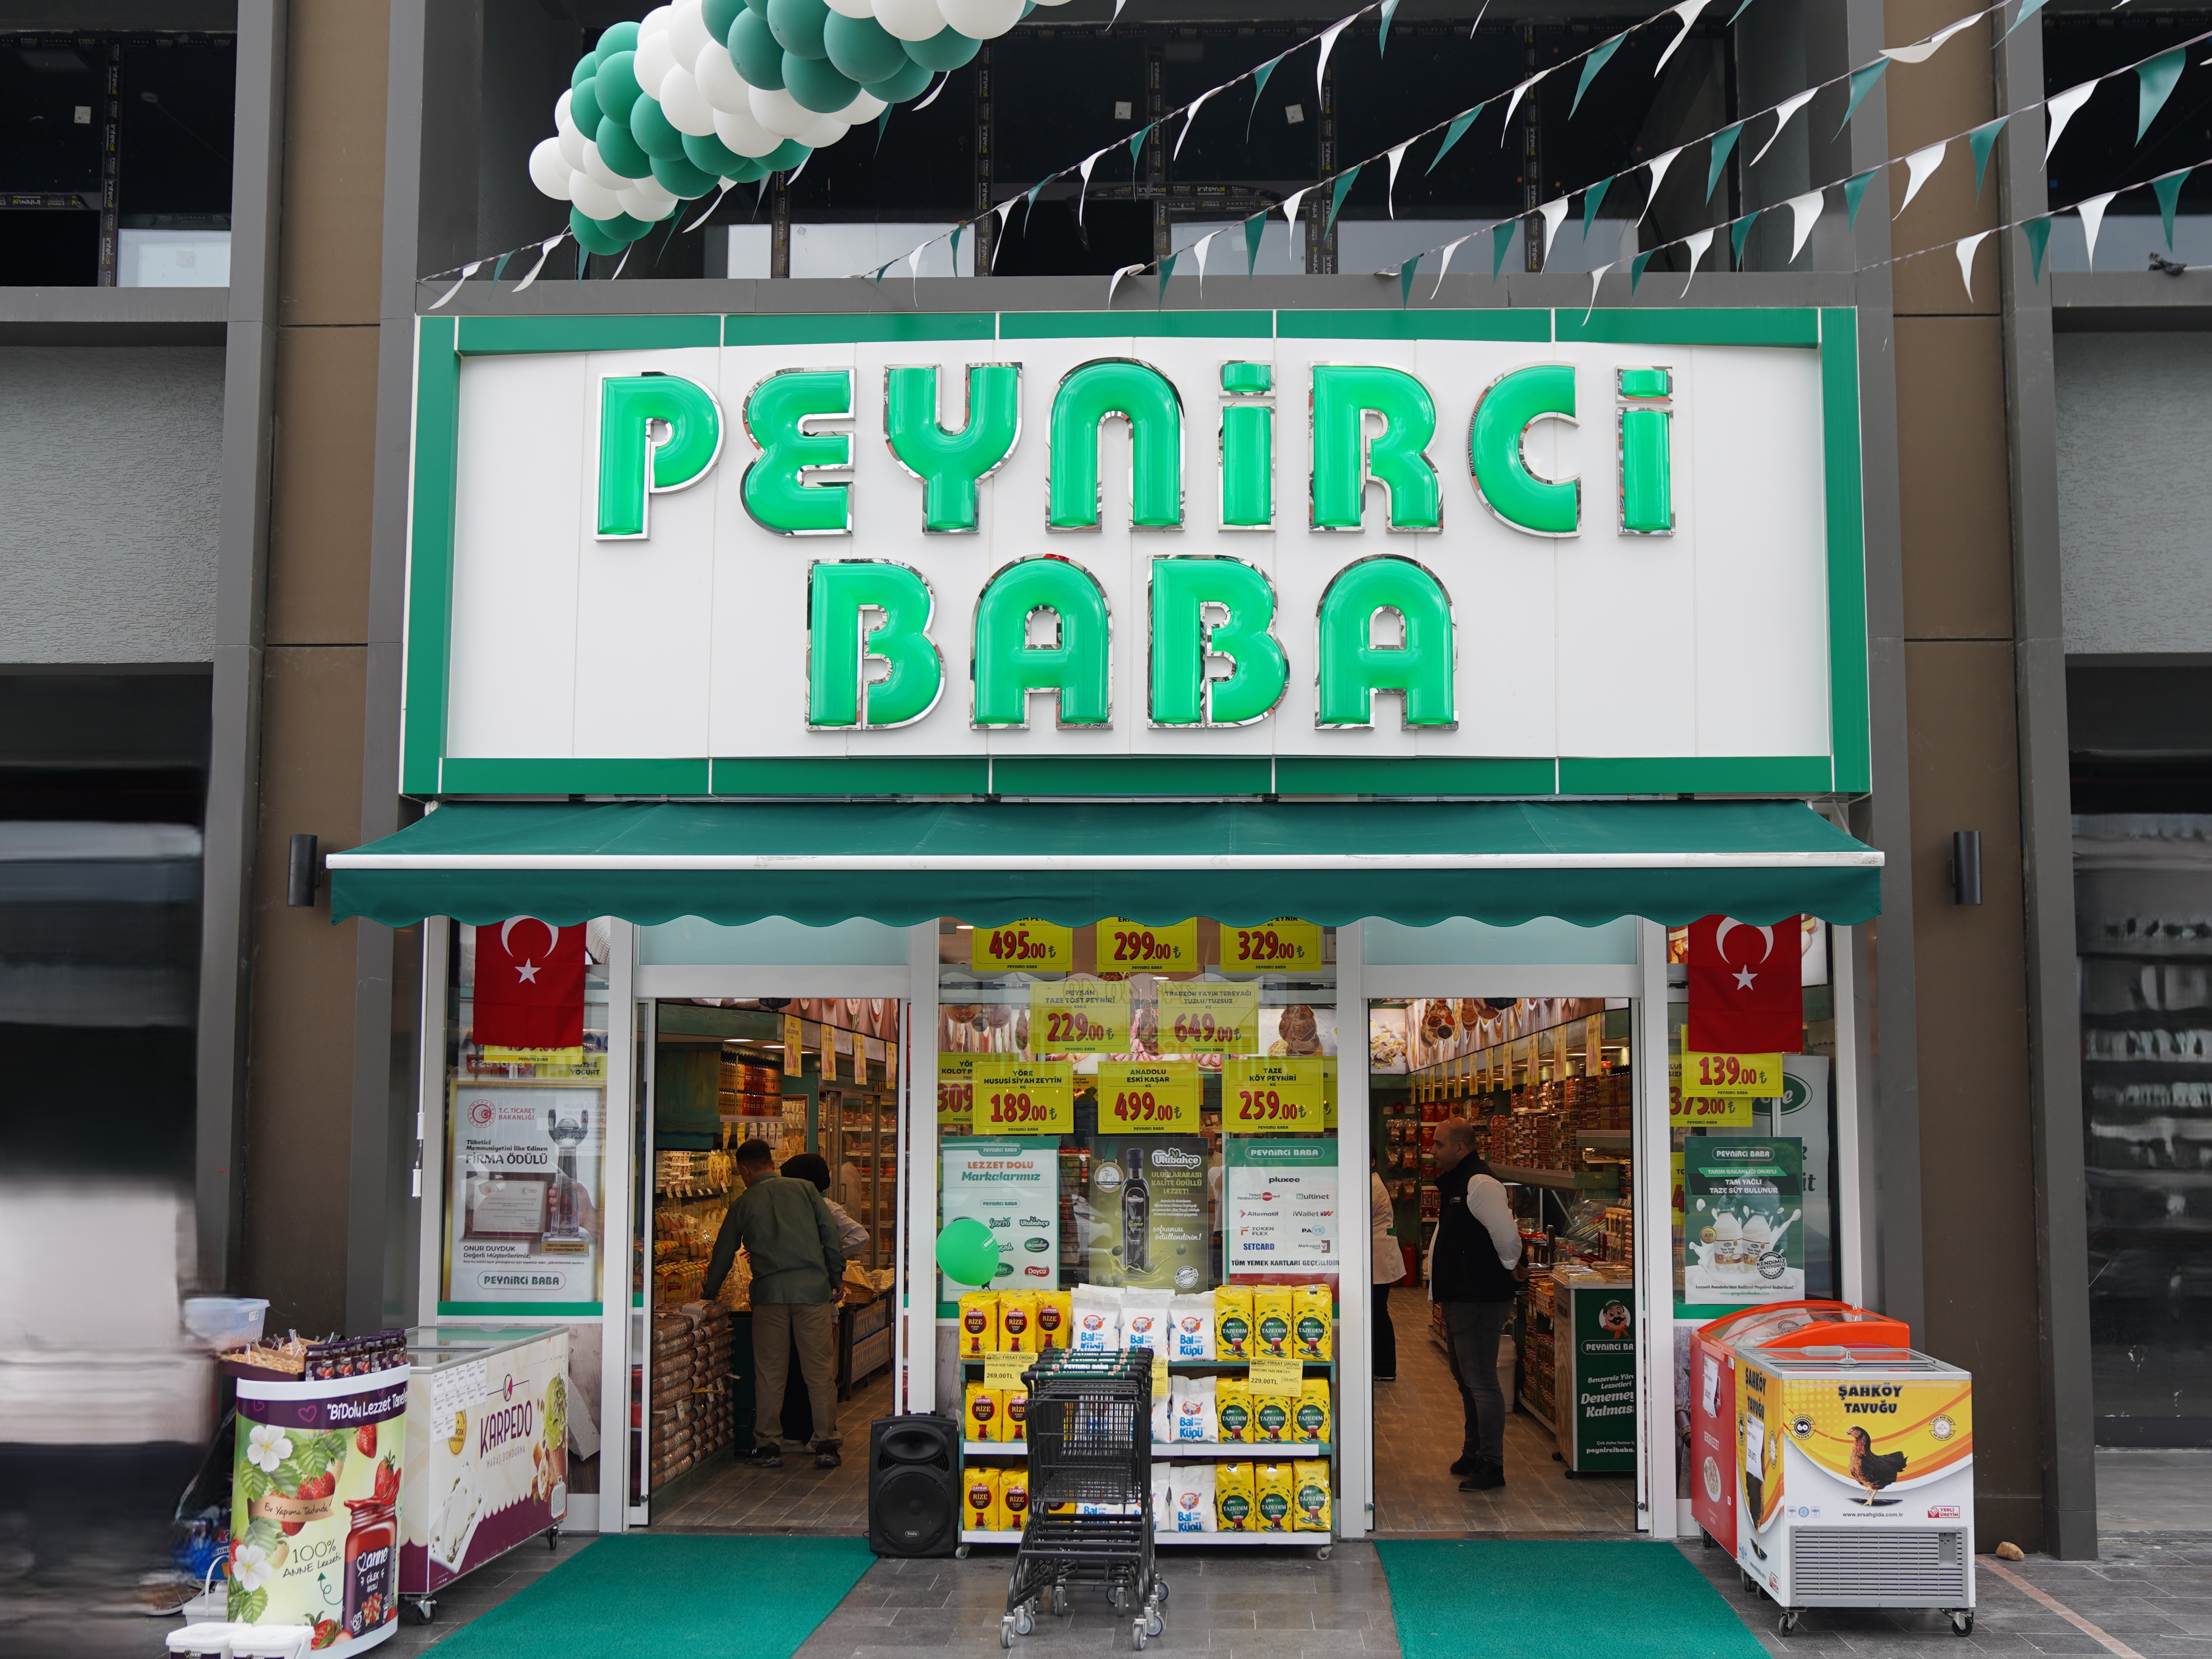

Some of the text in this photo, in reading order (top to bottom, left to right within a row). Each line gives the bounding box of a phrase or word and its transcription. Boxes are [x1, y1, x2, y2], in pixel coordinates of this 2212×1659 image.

[593, 356, 1676, 541] PEYNİRCİ
[805, 553, 1458, 732] BABA
[466, 1152, 548, 1164] FİRMA ÖDÜLÜ
[1154, 1154, 1198, 1167] Ulubahçe
[961, 1171, 1040, 1181] Markalarımız
[1019, 1219, 1050, 1228] Ulubahçe
[1152, 1225, 1184, 1234] sofranızı
[532, 1276, 559, 1285] BABA
[1081, 1332, 1095, 1342] Bal
[1130, 1334, 1144, 1344] Bal
[1180, 1334, 1194, 1344] Bal
[1180, 1344, 1203, 1357] Küpü
[1588, 1375, 1619, 1383] Benzersiz
[1600, 1381, 1631, 1389] Lezzetleri
[1745, 1367, 1767, 1397] ŞAHKÖY
[1838, 1382, 1904, 1400] ŞAHKÖY
[362, 1399, 391, 1416] Lezzet
[976, 1405, 991, 1413] RİZE
[1747, 1394, 1765, 1420] TAVUĞU
[1844, 1400, 1898, 1414] TAVUĞU
[1180, 1417, 1193, 1426] Bal
[480, 1400, 532, 1460] KARPEDO
[1179, 1427, 1203, 1439] Küpü
[487, 1445, 525, 1469] MARAŞ DONDURMA
[973, 1491, 988, 1501] RİZE
[265, 1502, 328, 1519] Ev Yapımı Tadında
[1178, 1512, 1192, 1522] Bal
[293, 1538, 336, 1563] 100%
[366, 1547, 389, 1569] anne
[283, 1552, 342, 1578] ANNE Lezzeti
[366, 1570, 380, 1584] ÇİLEK
